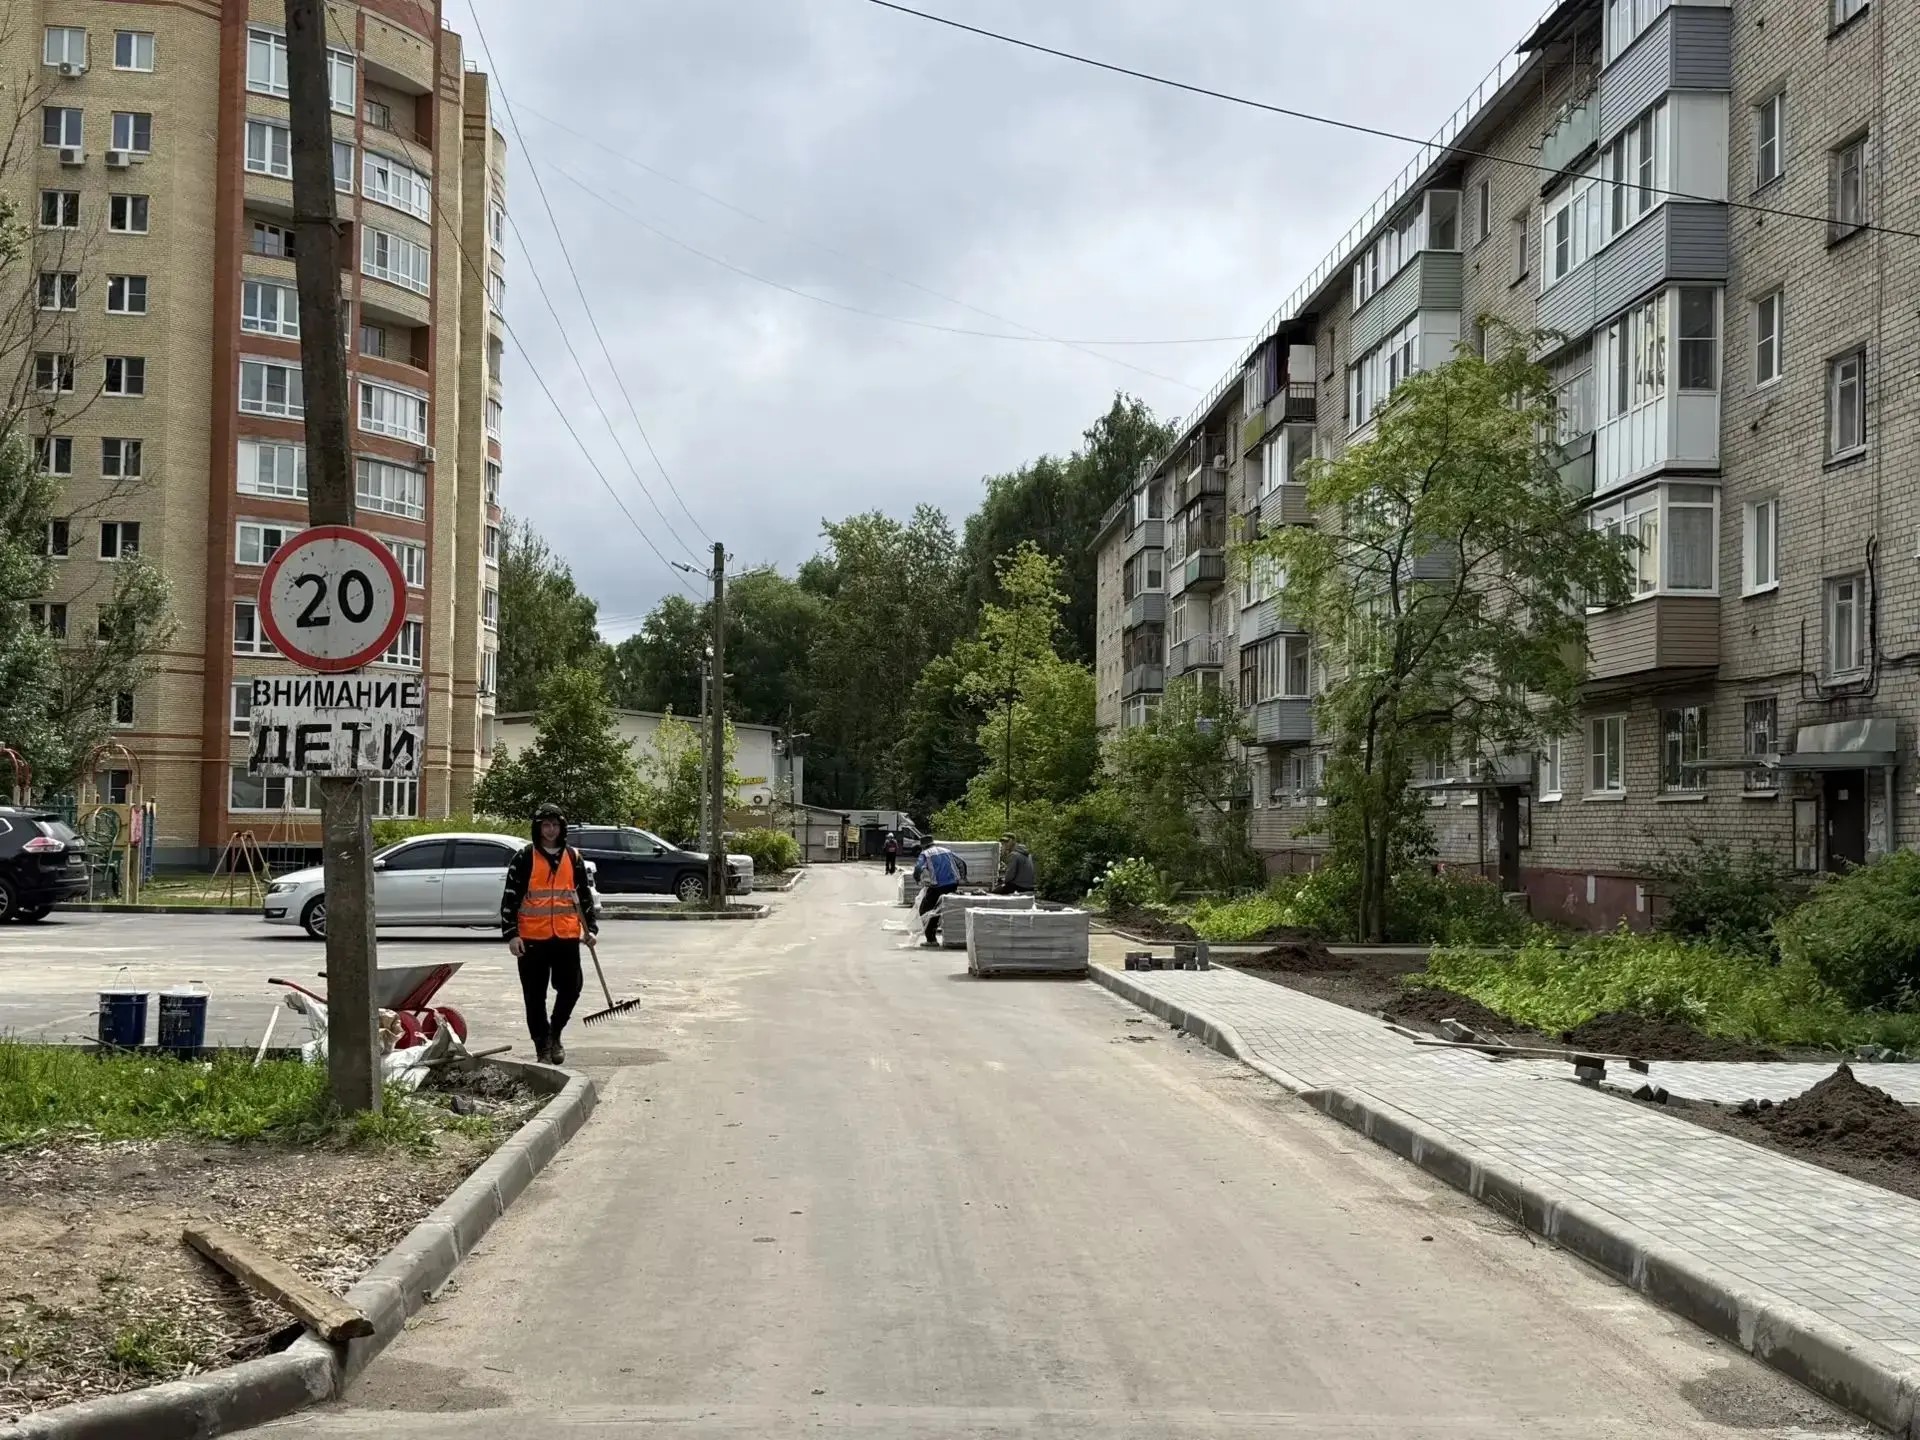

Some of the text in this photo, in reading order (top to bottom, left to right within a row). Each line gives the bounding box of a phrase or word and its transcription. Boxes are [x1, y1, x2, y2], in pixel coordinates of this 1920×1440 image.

[294, 569, 374, 628] 20
[253, 679, 421, 709] ВНИМАНИЕ
[249, 722, 415, 772] ДЕТИ
